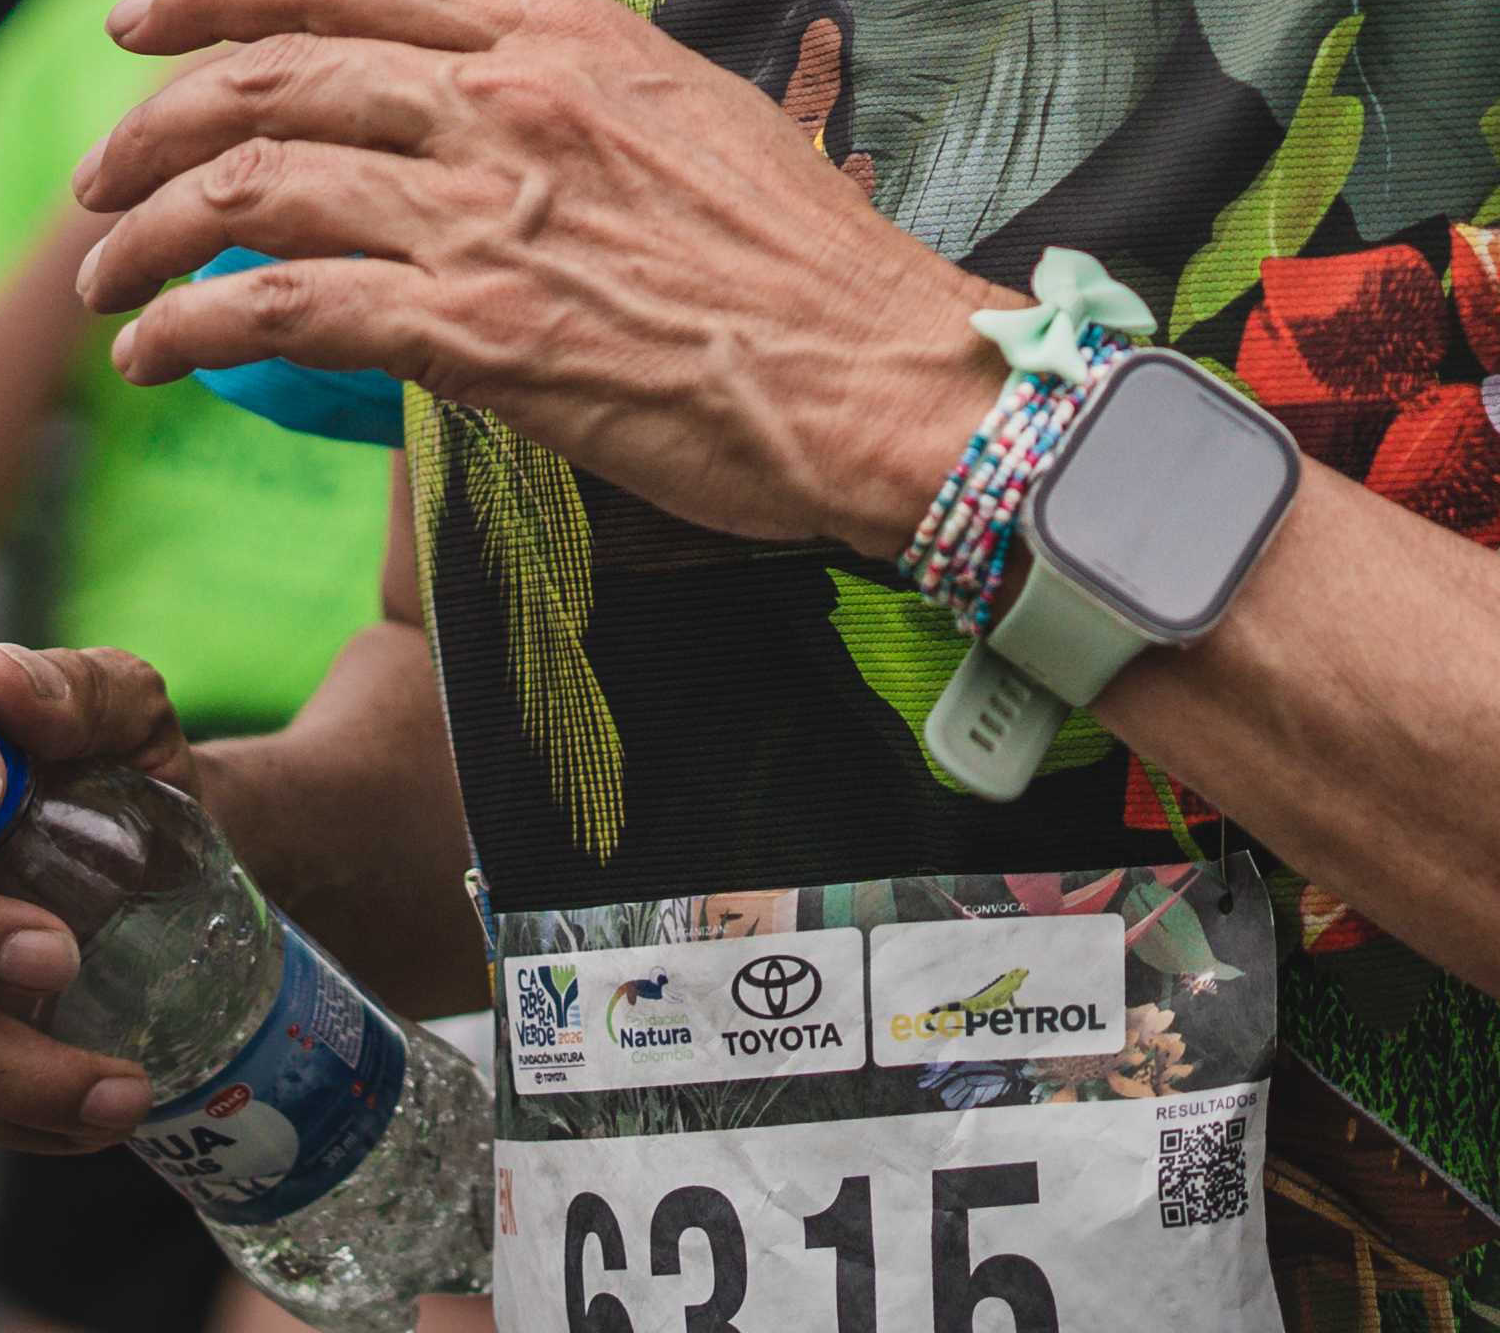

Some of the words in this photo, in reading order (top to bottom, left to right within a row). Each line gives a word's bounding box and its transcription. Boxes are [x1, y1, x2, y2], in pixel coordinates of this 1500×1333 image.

[961, 902, 1030, 916] CONVOCA:
[625, 1012, 690, 1029] Fundación
[557, 1031, 584, 1045] 2026
[619, 1026, 692, 1049] Natura
[721, 1022, 843, 1056] TOYOTA
[518, 1051, 553, 1065] FUNDACIÓN
[553, 1051, 585, 1064] NATURA
[631, 1047, 694, 1064] Colombia
[543, 1071, 568, 1082] TOYOTA
[1155, 1092, 1258, 1121] RESULTADOS
[126, 1125, 238, 1161] GUA
[563, 1159, 1059, 1333] 6315
